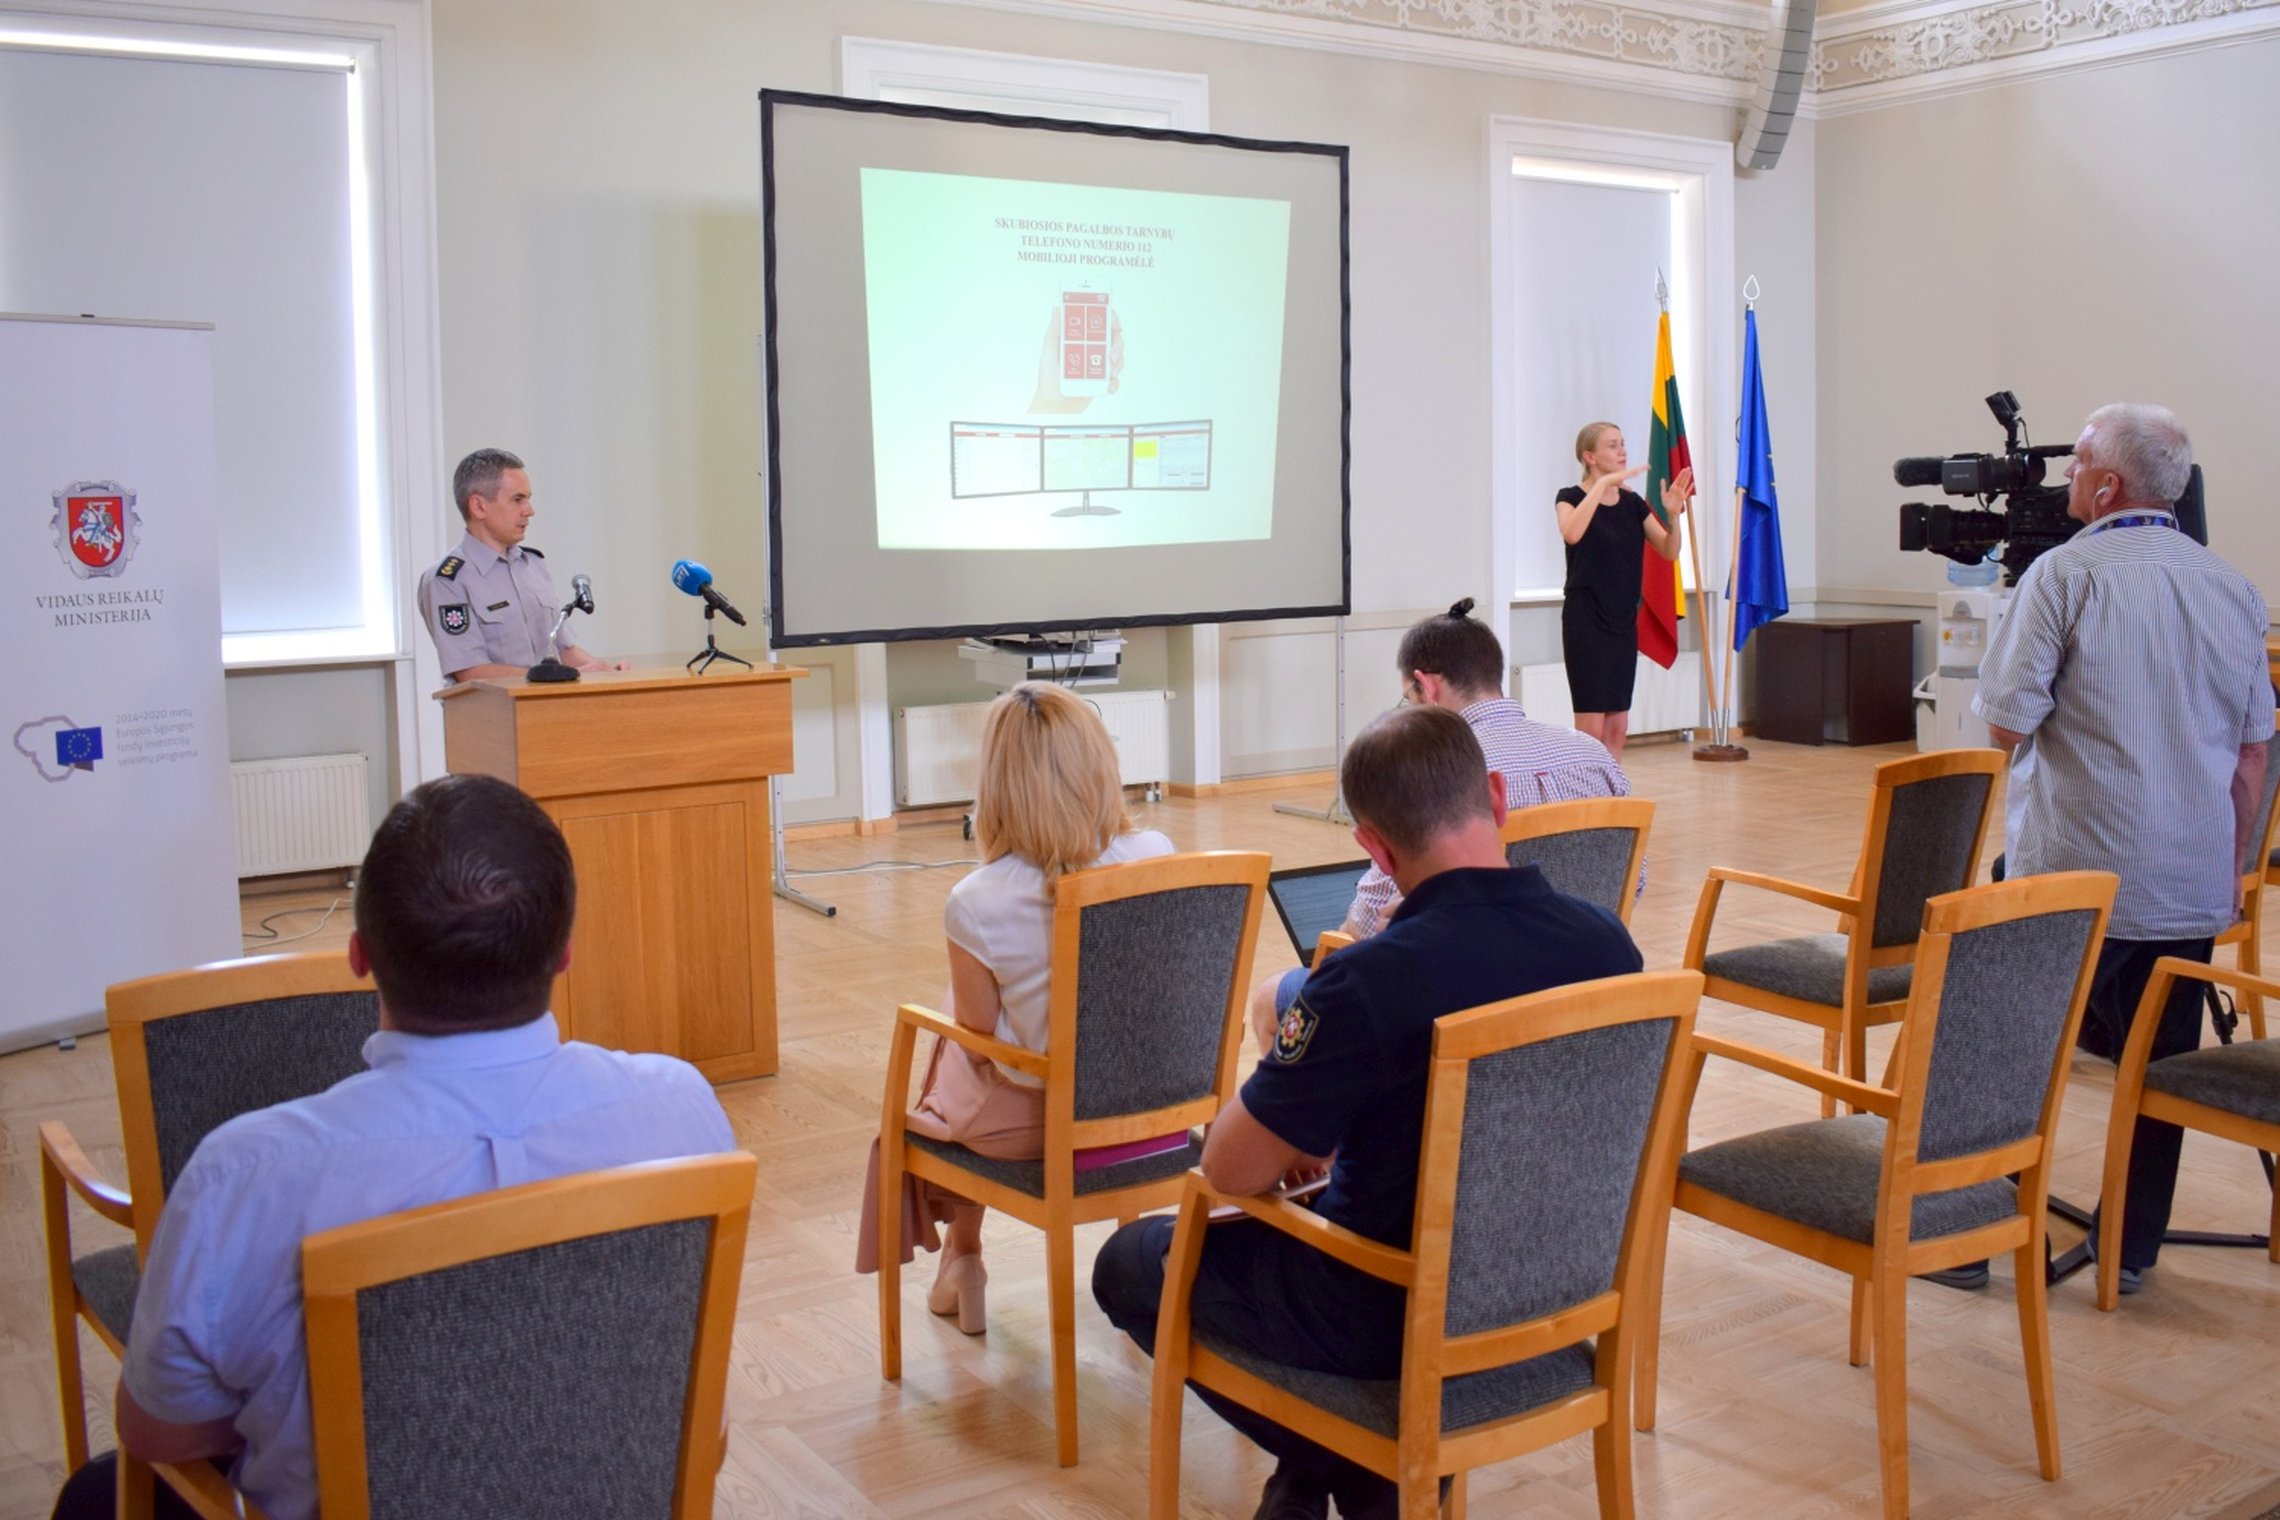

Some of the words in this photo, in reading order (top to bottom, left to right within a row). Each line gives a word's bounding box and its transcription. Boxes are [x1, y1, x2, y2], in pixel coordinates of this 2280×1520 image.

[994, 217, 1064, 232] SKUBIOSIOS
[1066, 222, 1124, 236] PAGALBOS
[1021, 235, 1081, 249] TELEFONO
[1083, 238, 1135, 252] NUMERIO
[1137, 241, 1152, 253] 112
[1017, 251, 1077, 265] MOBILIOJI
[35, 593, 95, 609] VIDAUS
[98, 589, 165, 605] REIKALŲ
[54, 608, 152, 627] MINISTERIJA
